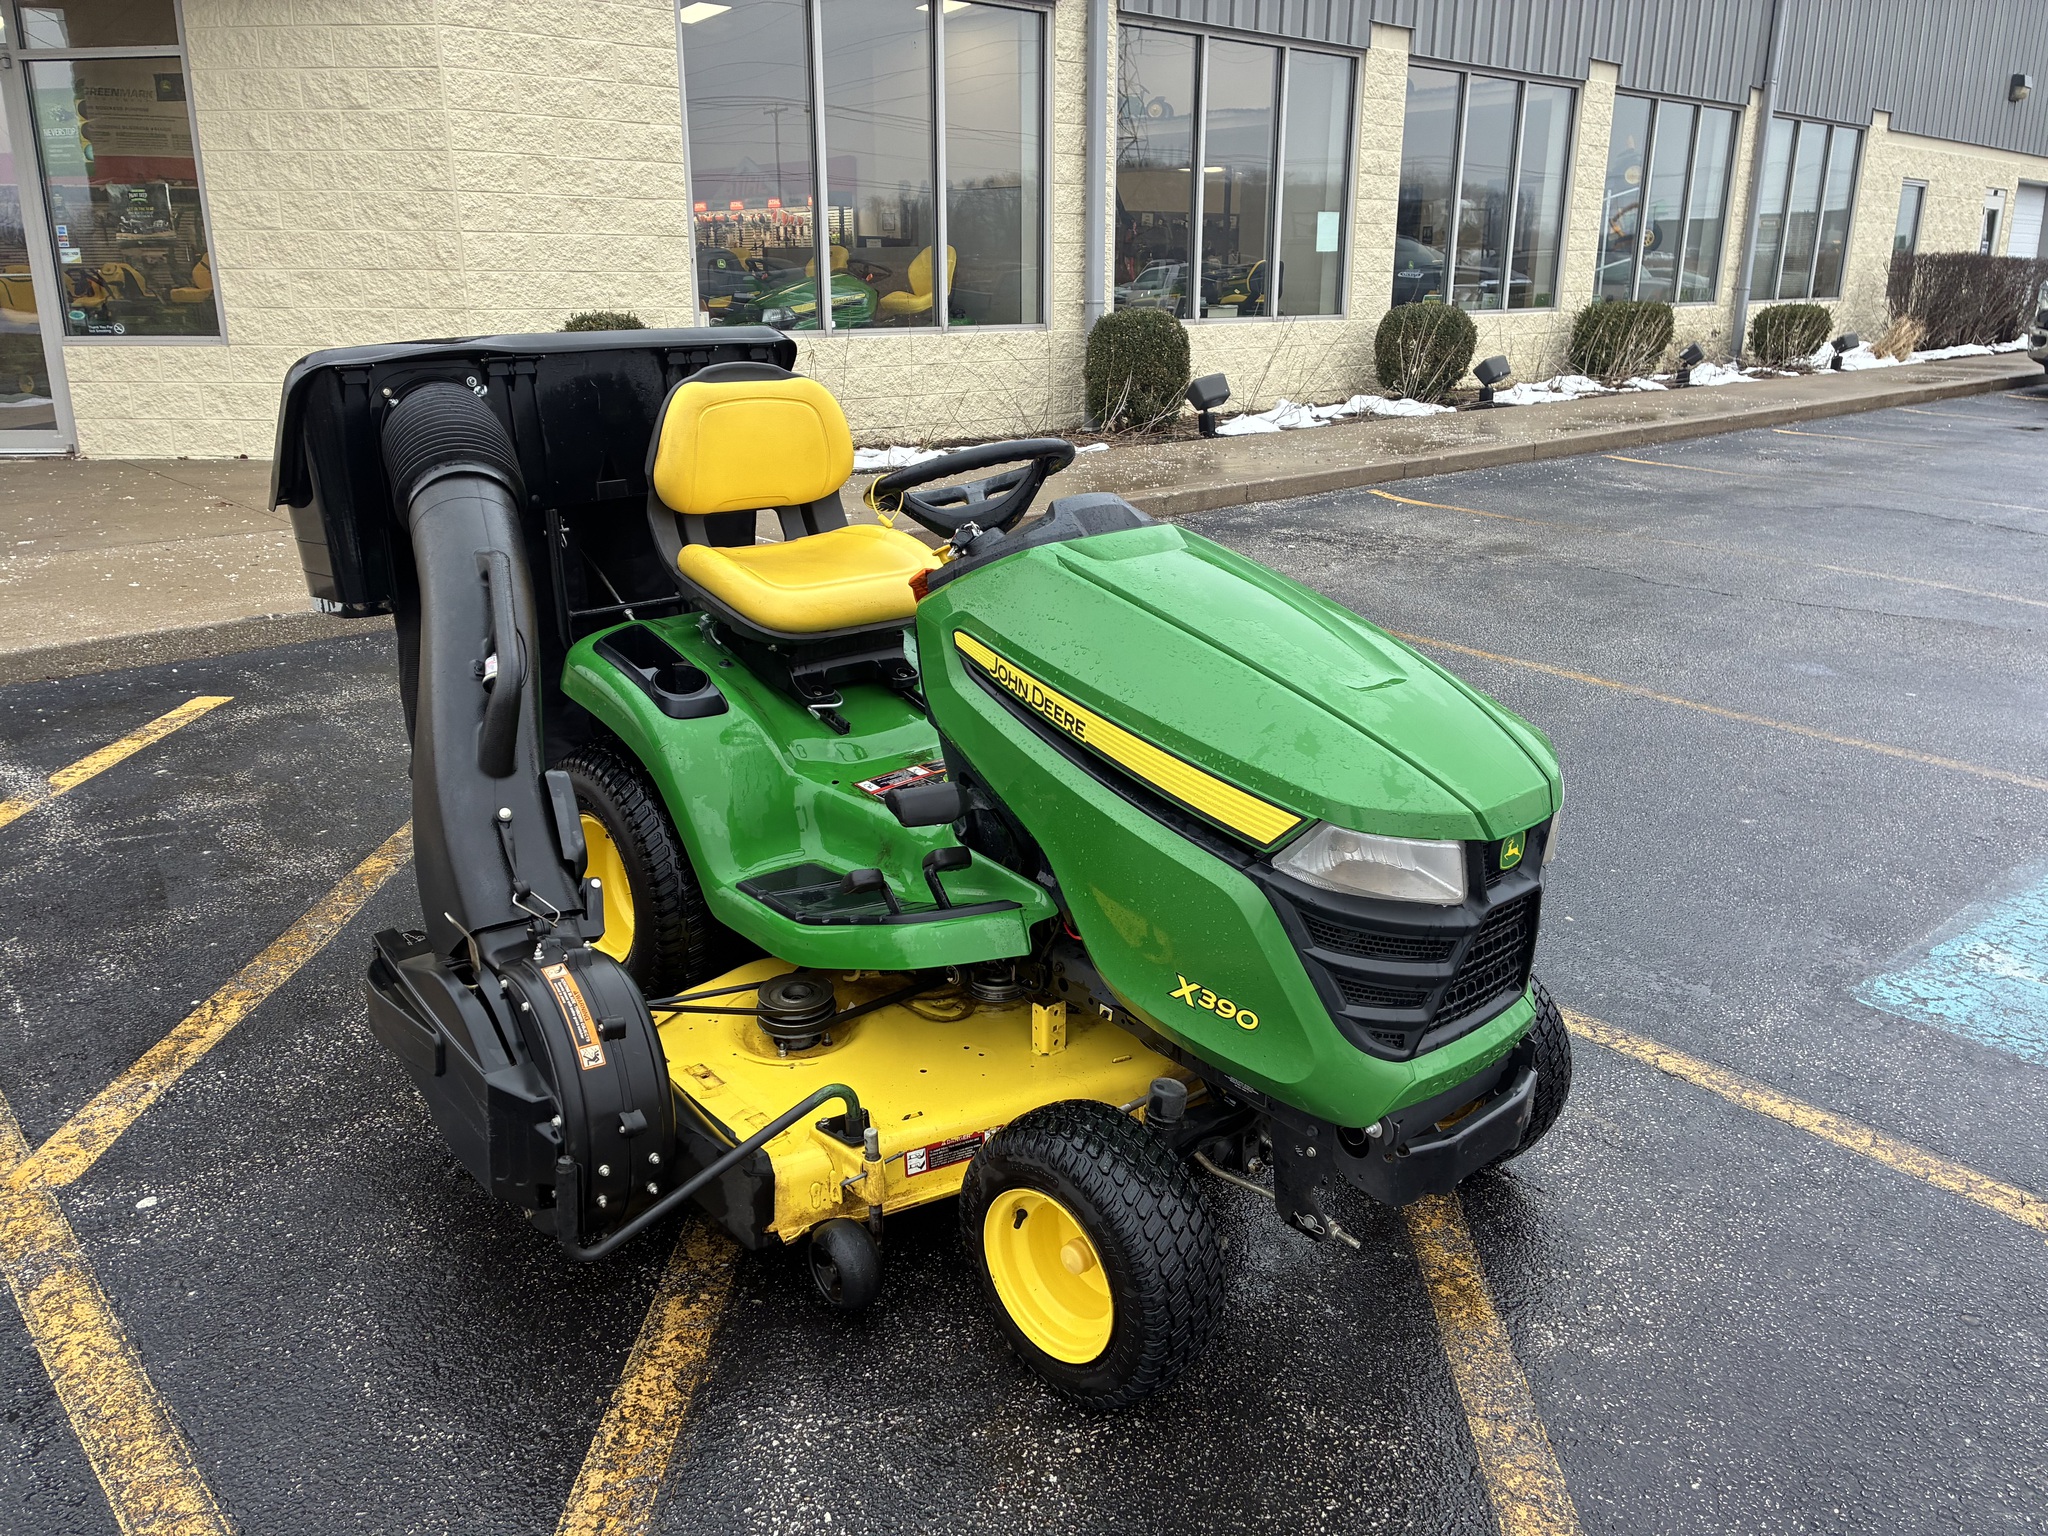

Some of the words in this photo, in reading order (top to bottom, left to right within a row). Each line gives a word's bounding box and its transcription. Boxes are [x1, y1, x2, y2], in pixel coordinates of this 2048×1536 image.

[83, 87, 153, 98] GREENMARK
[989, 656, 1029, 699] JOHN
[1031, 684, 1087, 739] DEERE
[574, 992, 591, 1021] WARNING
[1166, 972, 1260, 1031] X390
